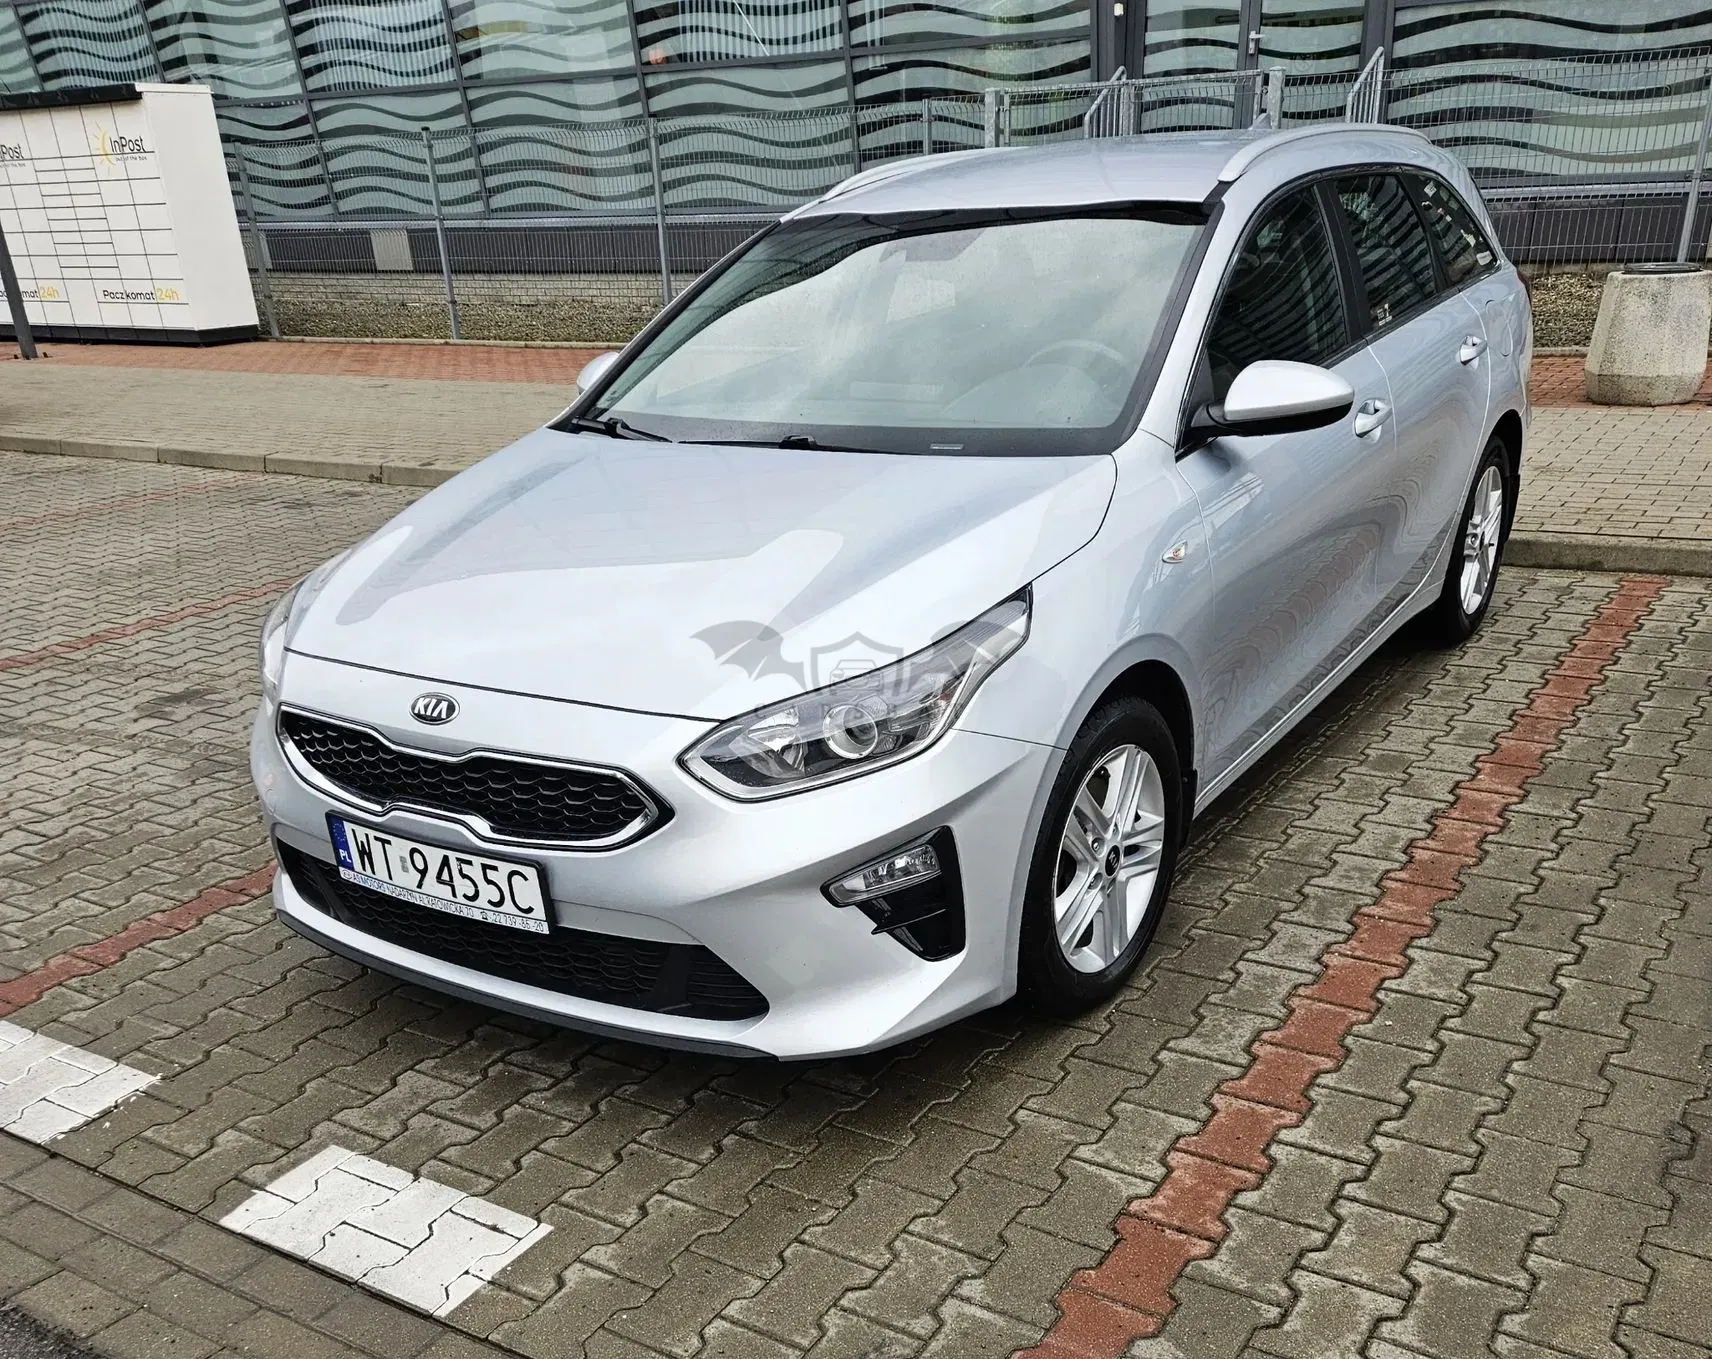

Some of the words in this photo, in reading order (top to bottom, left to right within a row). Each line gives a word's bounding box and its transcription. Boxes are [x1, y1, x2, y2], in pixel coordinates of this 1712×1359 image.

[0, 143, 24, 160] Post
[109, 135, 146, 153] InPost
[40, 286, 60, 299] 24h
[157, 287, 179, 300] 24h
[413, 696, 449, 719] KIA
[339, 848, 352, 863] PL
[352, 828, 393, 881] WT
[409, 847, 535, 915] 9455C
